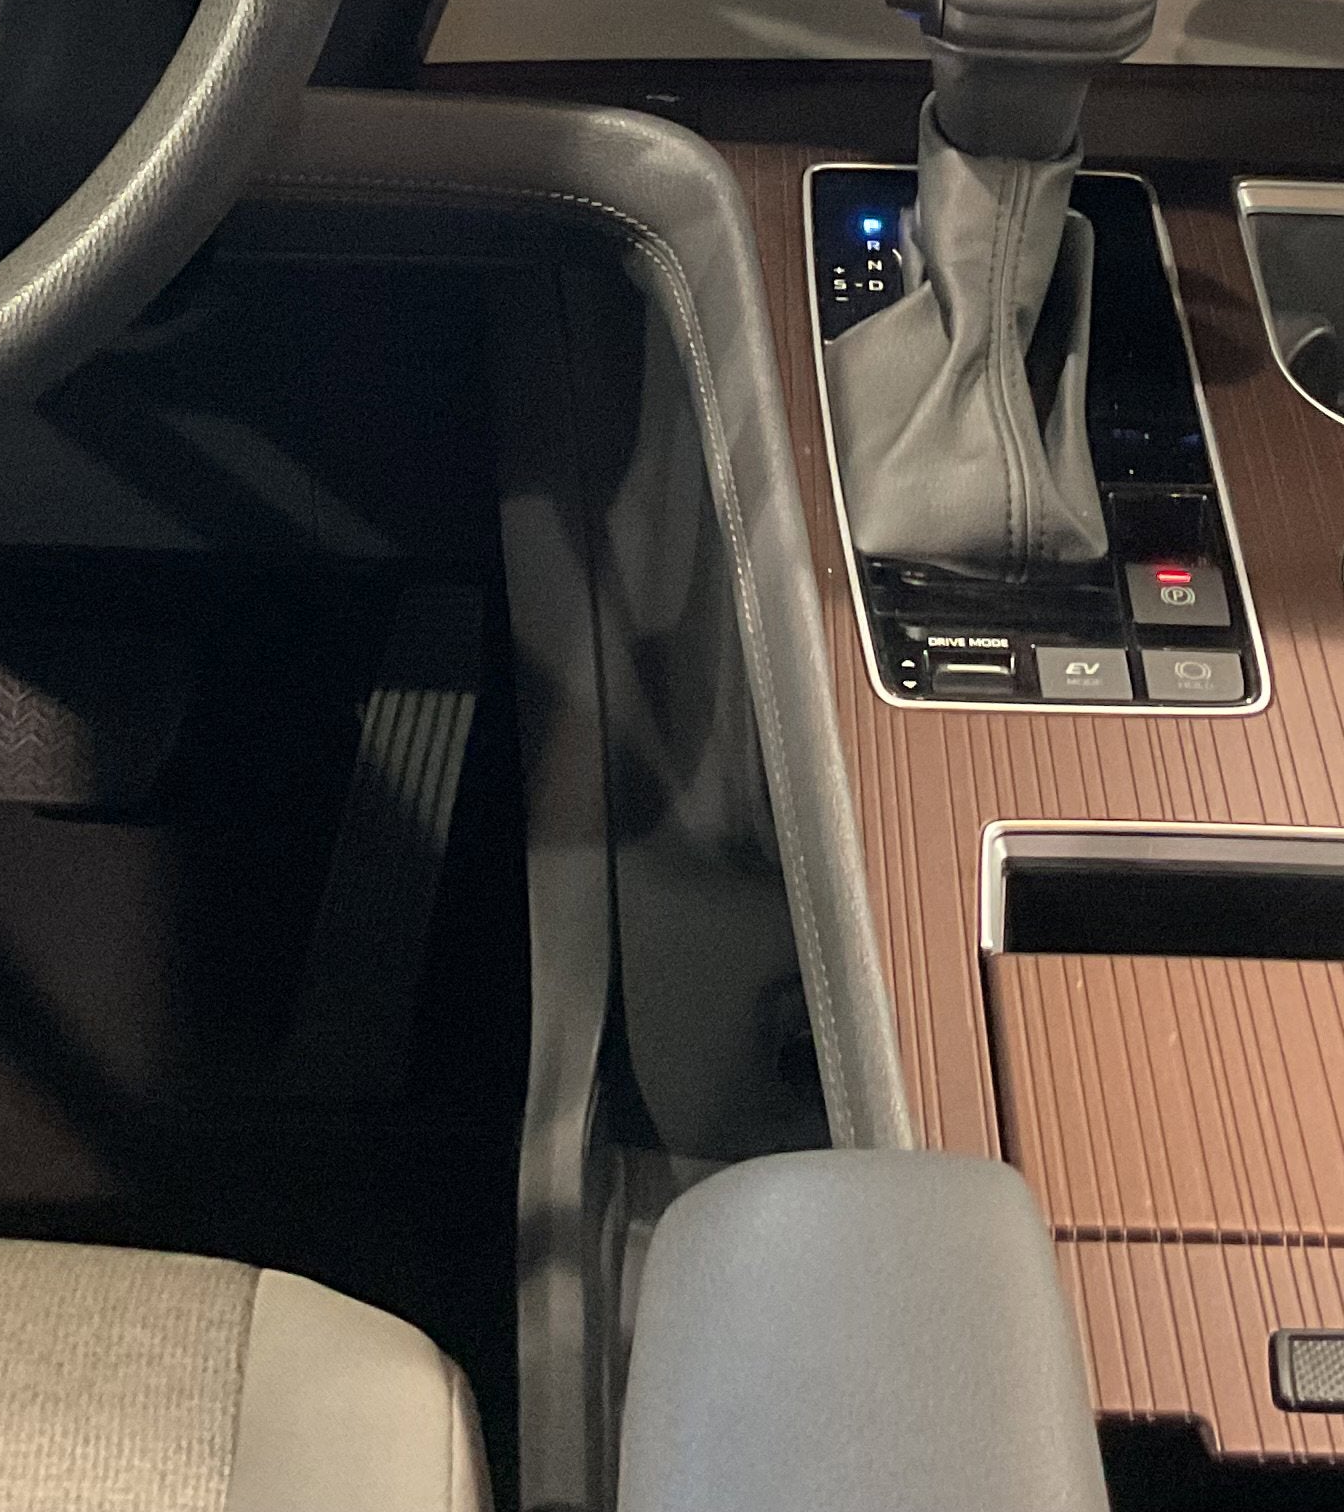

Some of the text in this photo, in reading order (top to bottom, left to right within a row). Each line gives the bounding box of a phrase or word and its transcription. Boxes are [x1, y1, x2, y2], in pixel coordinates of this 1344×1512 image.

[867, 240, 880, 252] R
[867, 259, 882, 271] N
[833, 279, 847, 290] S
[868, 280, 884, 291] D
[928, 636, 1009, 649] DRIVE MODE
[1065, 661, 1101, 676] EV
